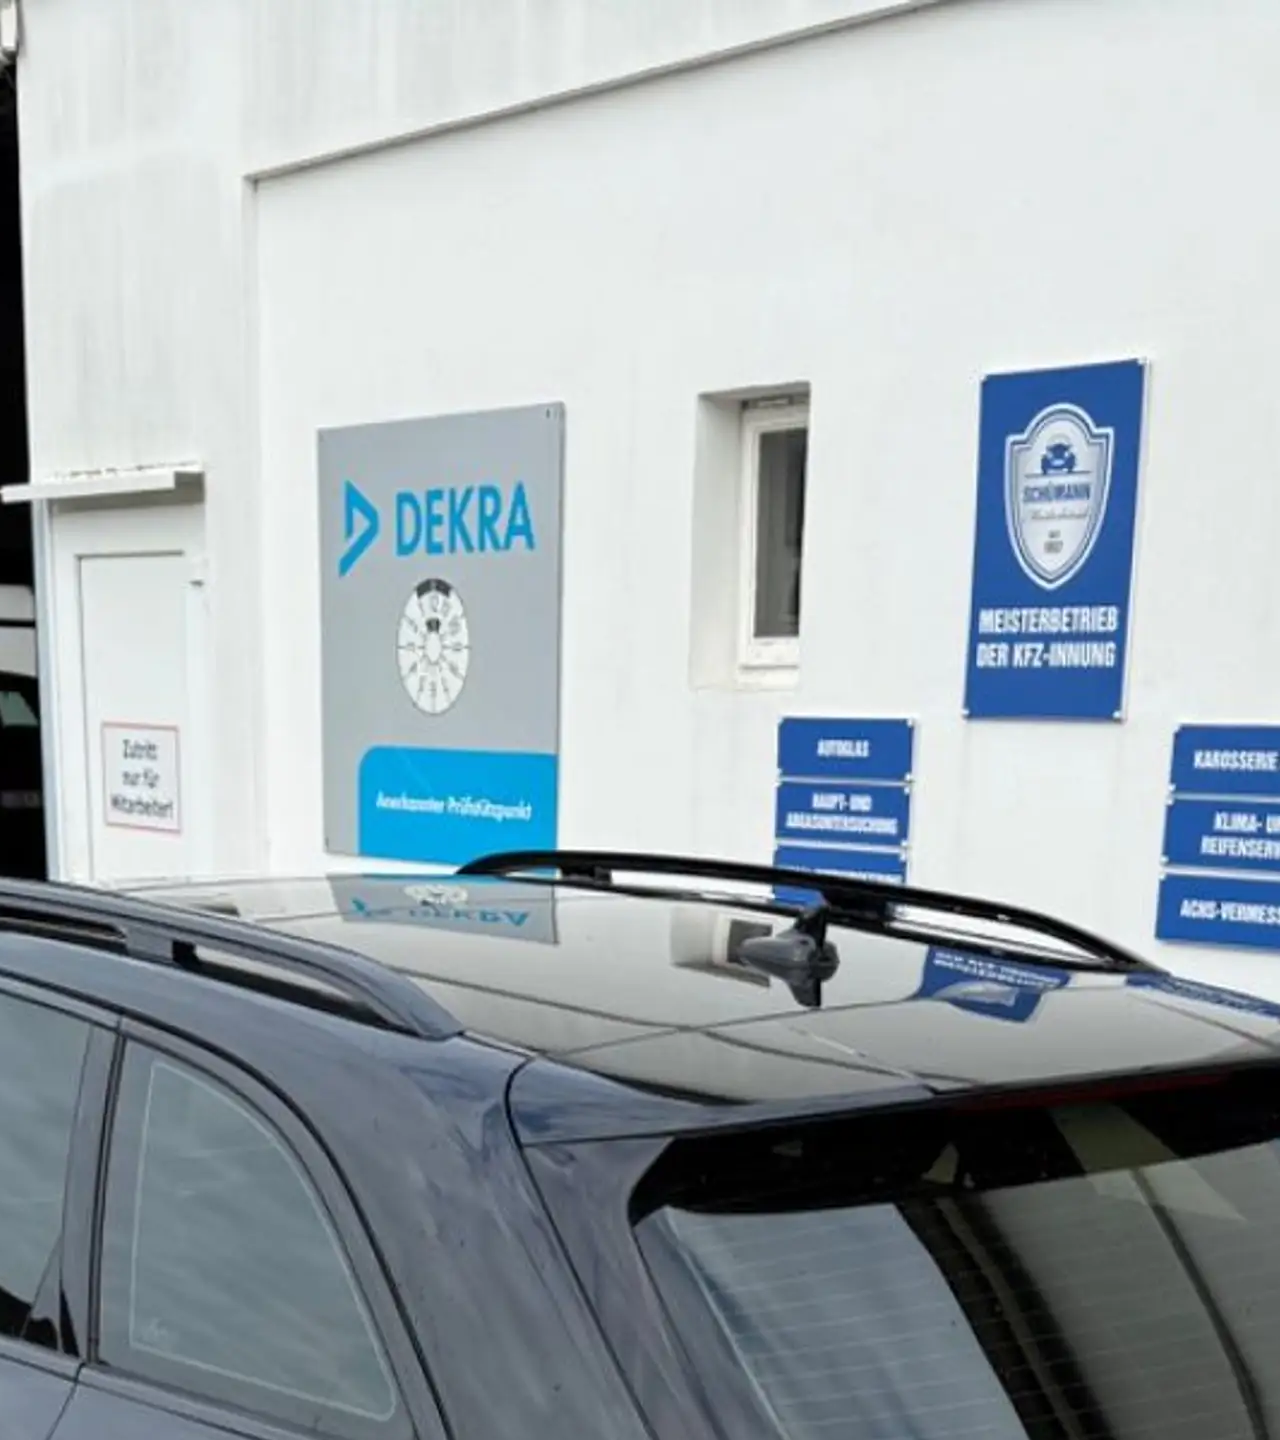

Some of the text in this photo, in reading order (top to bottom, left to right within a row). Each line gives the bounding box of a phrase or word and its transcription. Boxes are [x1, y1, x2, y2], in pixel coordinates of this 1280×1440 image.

[395, 479, 536, 557] DEKRA
[978, 605, 1118, 634] MEISTERBETRIEB
[976, 641, 1117, 669] DER KFZ-INNUNG
[1193, 749, 1279, 772] KAROSSERIE
[1213, 811, 1263, 833] KLIMA-
